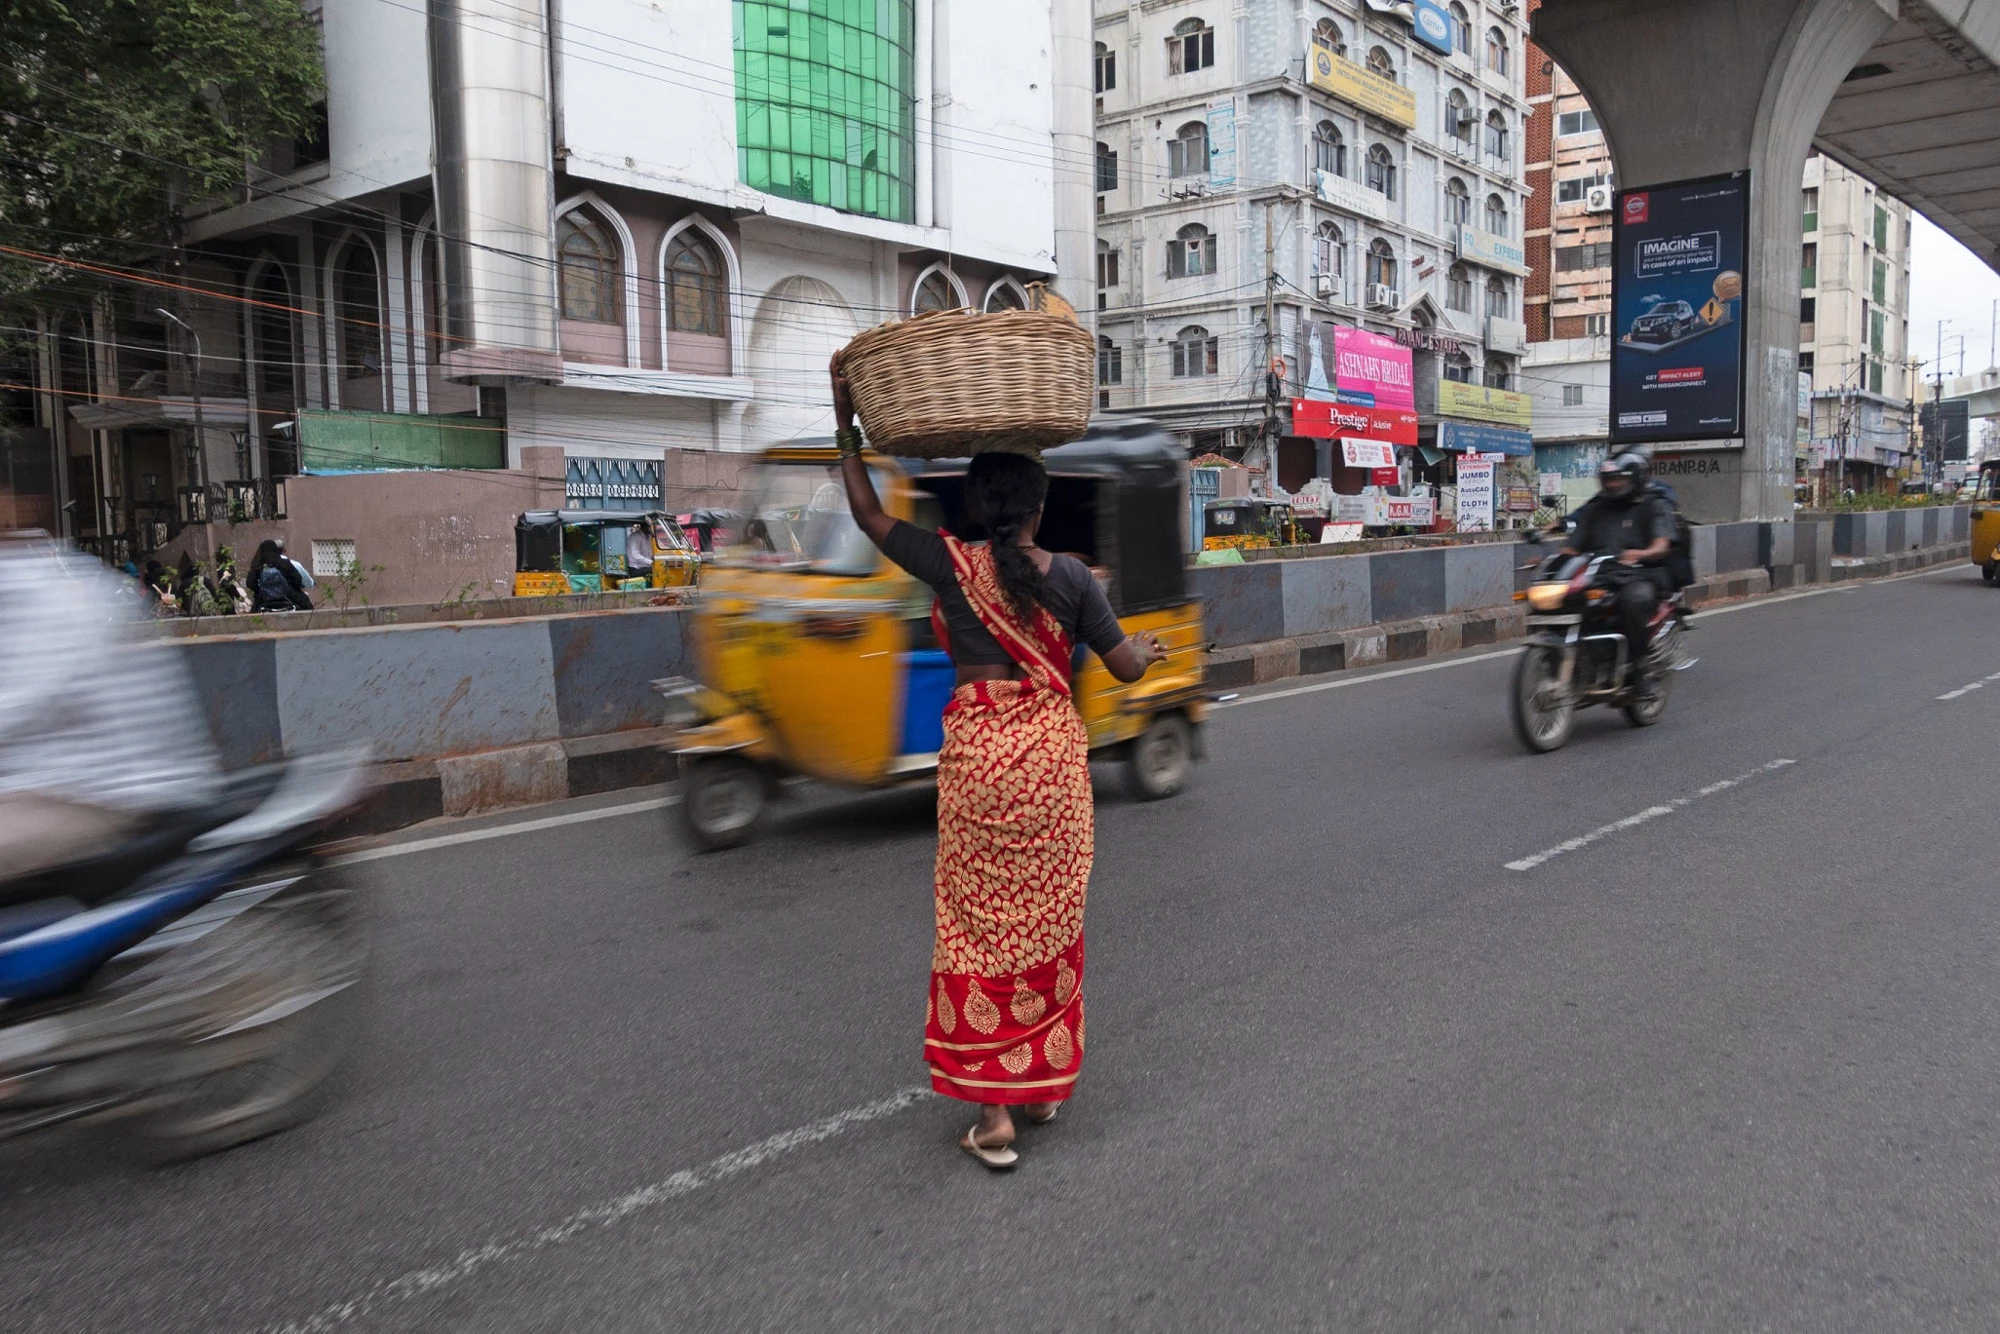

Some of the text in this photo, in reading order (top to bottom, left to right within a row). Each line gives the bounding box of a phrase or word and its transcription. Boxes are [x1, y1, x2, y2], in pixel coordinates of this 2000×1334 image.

[1494, 242, 1522, 263] EXPRESS
[1644, 238, 1700, 254] IMAGINE
[1650, 261, 1667, 269] case
[1668, 258, 1676, 266] of
[1687, 256, 1713, 265] impact
[1428, 335, 1462, 355] ESTATES
[1339, 351, 1411, 386] ASHNAHS BRIDAL
[1658, 380, 1706, 389] NISSANCONNECT
[1329, 408, 1369, 430] Prestige
[1460, 471, 1489, 479] JUMBO
[1390, 504, 1431, 517] K.G.N. Xerox
